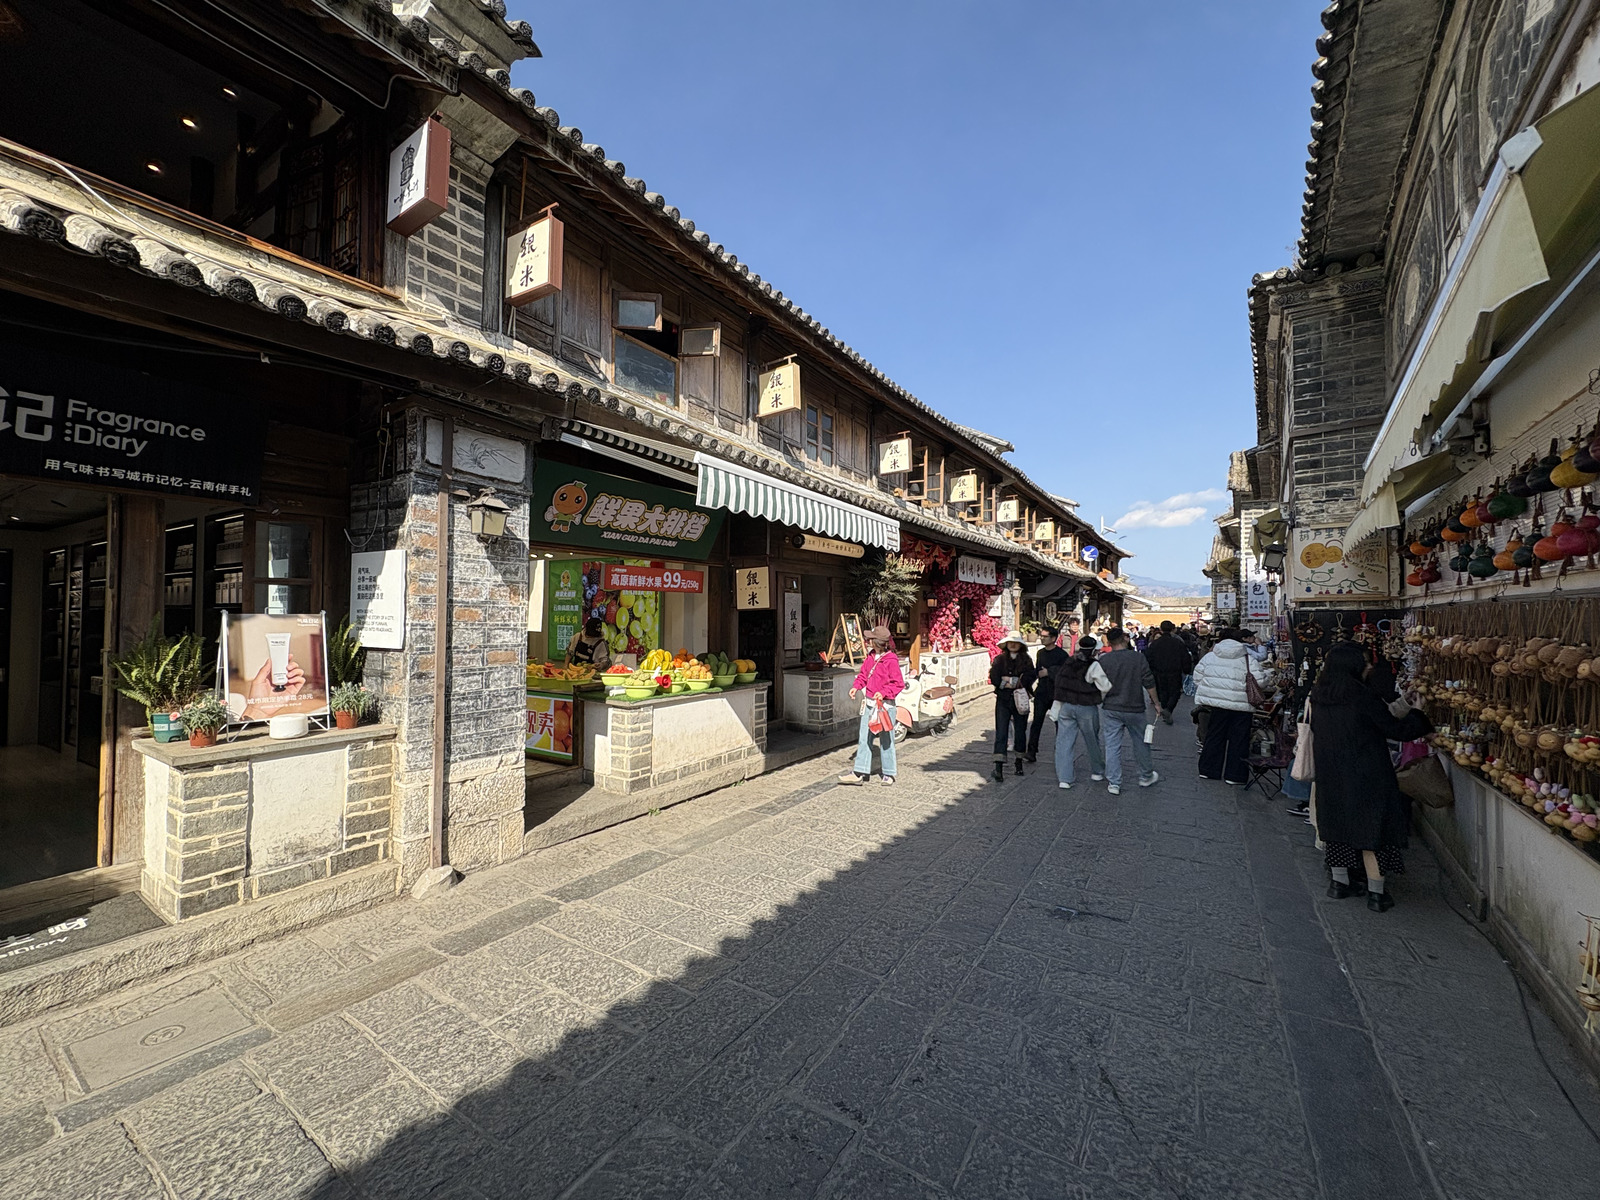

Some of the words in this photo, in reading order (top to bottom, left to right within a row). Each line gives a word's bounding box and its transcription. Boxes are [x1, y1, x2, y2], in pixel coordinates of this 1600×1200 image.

[66, 398, 207, 442] Fragrance
[44, 457, 252, 497] 用气味书写城市记忆-云南伴手礼
[584, 494, 709, 540] 鲜果大排档
[601, 531, 621, 541] XIAN
[638, 536, 649, 544] DA
[610, 573, 662, 588] 高原新鲜水果
